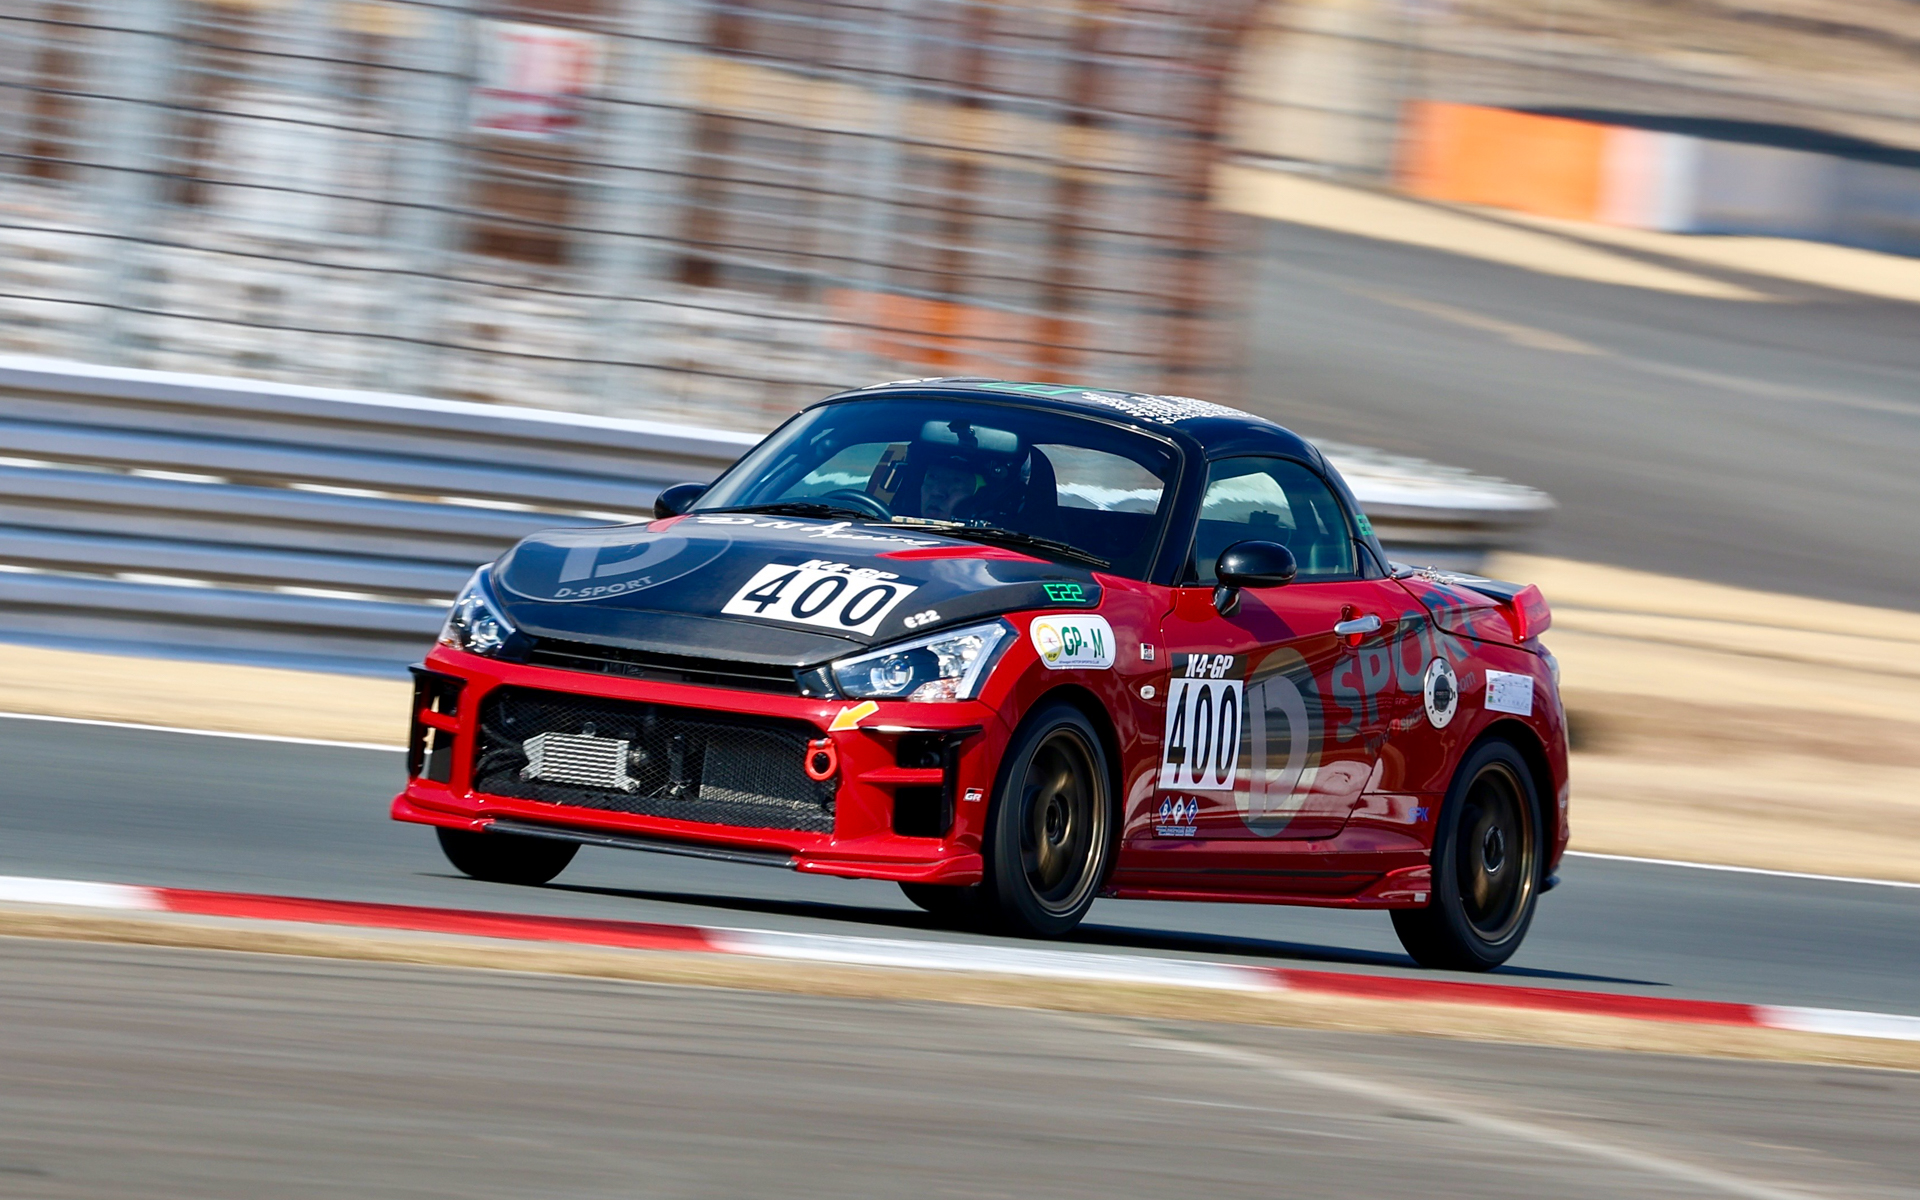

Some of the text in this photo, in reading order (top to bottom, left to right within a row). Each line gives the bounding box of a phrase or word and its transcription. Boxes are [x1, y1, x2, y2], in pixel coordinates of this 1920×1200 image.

[554, 575, 654, 599] D-SPORT
[742, 569, 897, 627] 400
[1043, 584, 1087, 602] E22
[1331, 581, 1483, 742] SPORT
[1167, 682, 1237, 786] 400
[964, 792, 983, 802] GR
